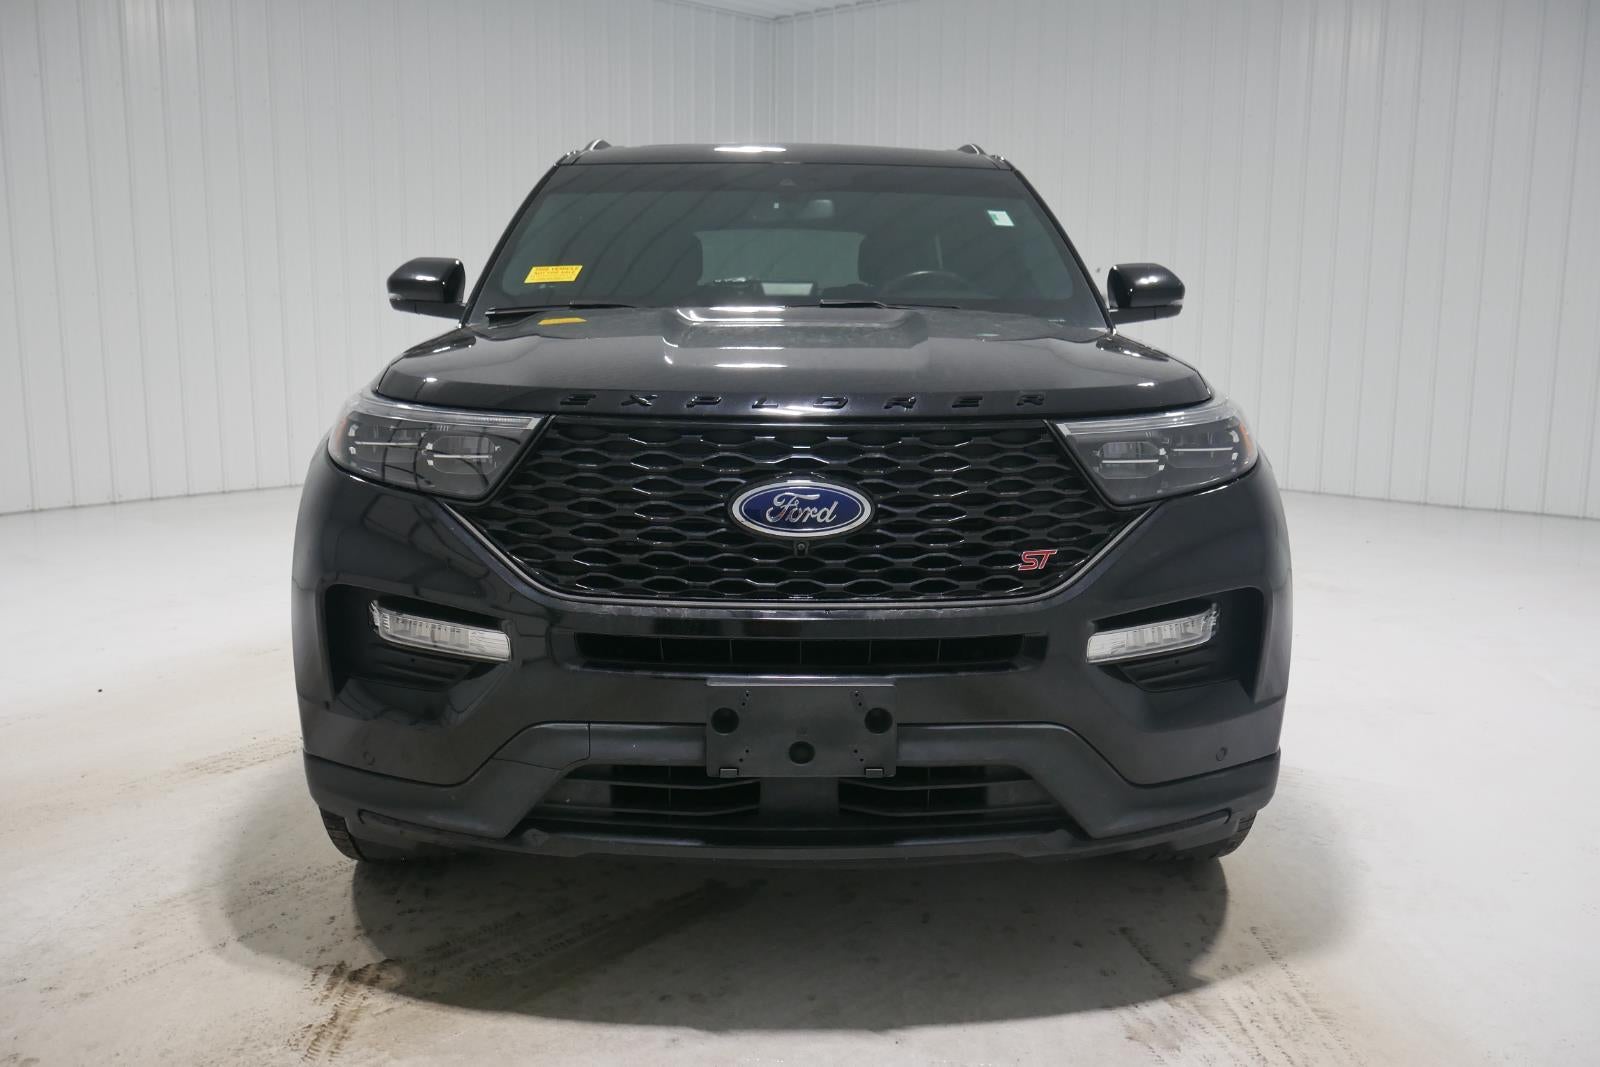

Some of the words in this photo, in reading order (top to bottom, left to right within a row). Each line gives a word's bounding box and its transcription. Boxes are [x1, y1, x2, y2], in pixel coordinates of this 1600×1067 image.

[559, 393, 1046, 409] EXPLORER
[766, 491, 839, 523] Ford
[1018, 549, 1058, 571] ST
